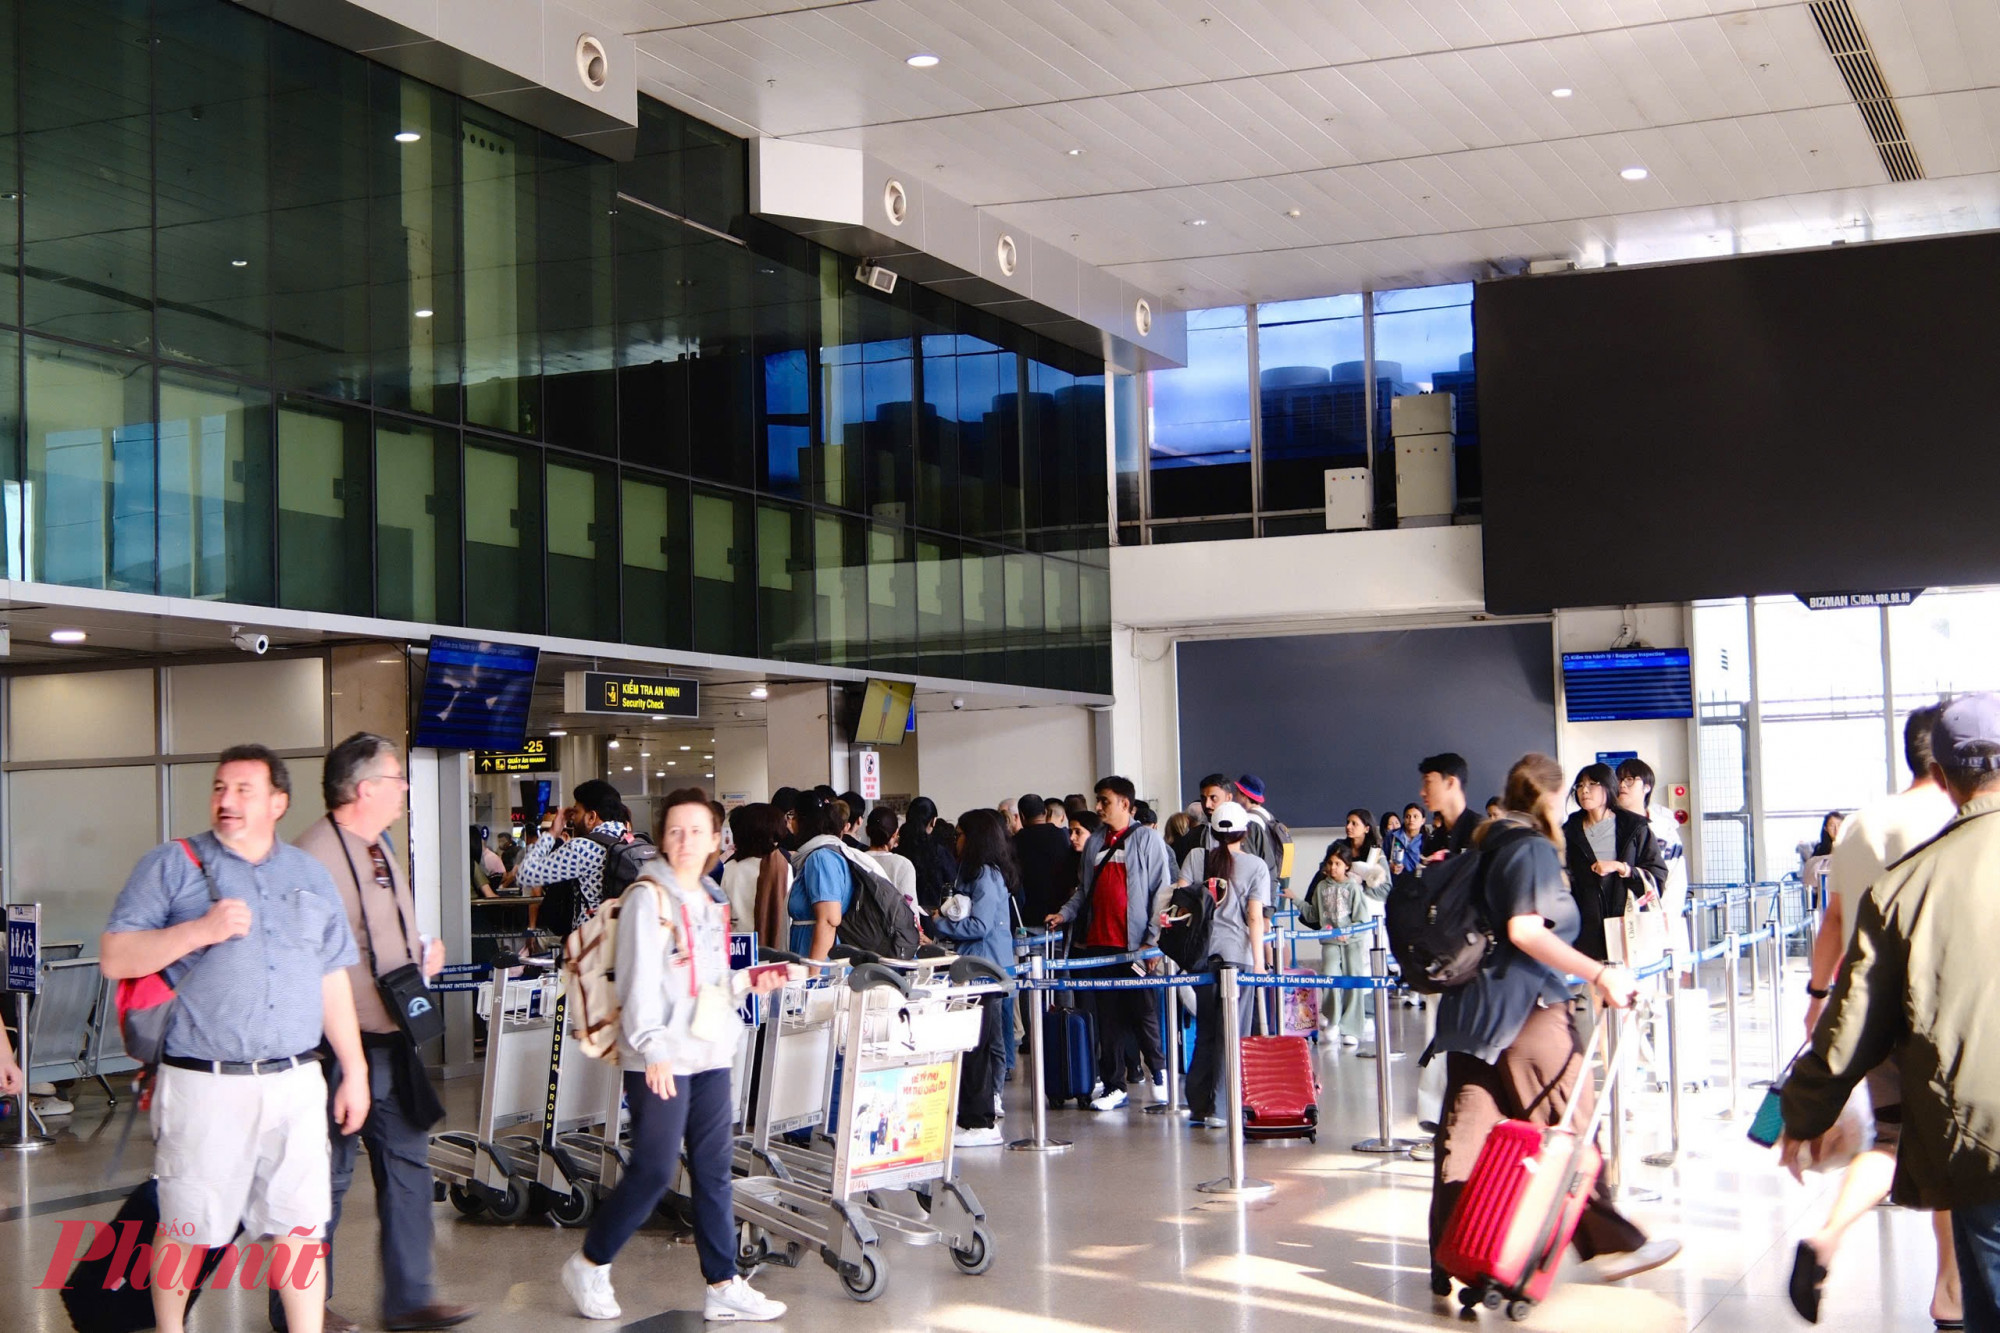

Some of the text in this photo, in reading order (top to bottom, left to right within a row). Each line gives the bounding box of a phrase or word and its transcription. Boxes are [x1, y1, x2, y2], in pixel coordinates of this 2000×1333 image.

[1809, 595, 1848, 608] BIZMAN
[622, 679, 680, 698] KIỂM TRA AN NINH
[622, 697, 665, 710] Security Check
[15, 906, 24, 915] TIA
[1045, 960, 1057, 968] TIA
[9, 978, 36, 988] PRIORITY LANE
[1113, 977, 1168, 987] INTERNATIONAL
[1169, 975, 1200, 984] AIRPORT
[1256, 975, 1275, 983] QUỐC
[1276, 975, 1285, 984] TẾ
[1286, 976, 1299, 984] TÂN
[1316, 976, 1335, 985] NHẤT
[1370, 978, 1397, 987] TIA
[545, 1083, 556, 1130] GROUP
